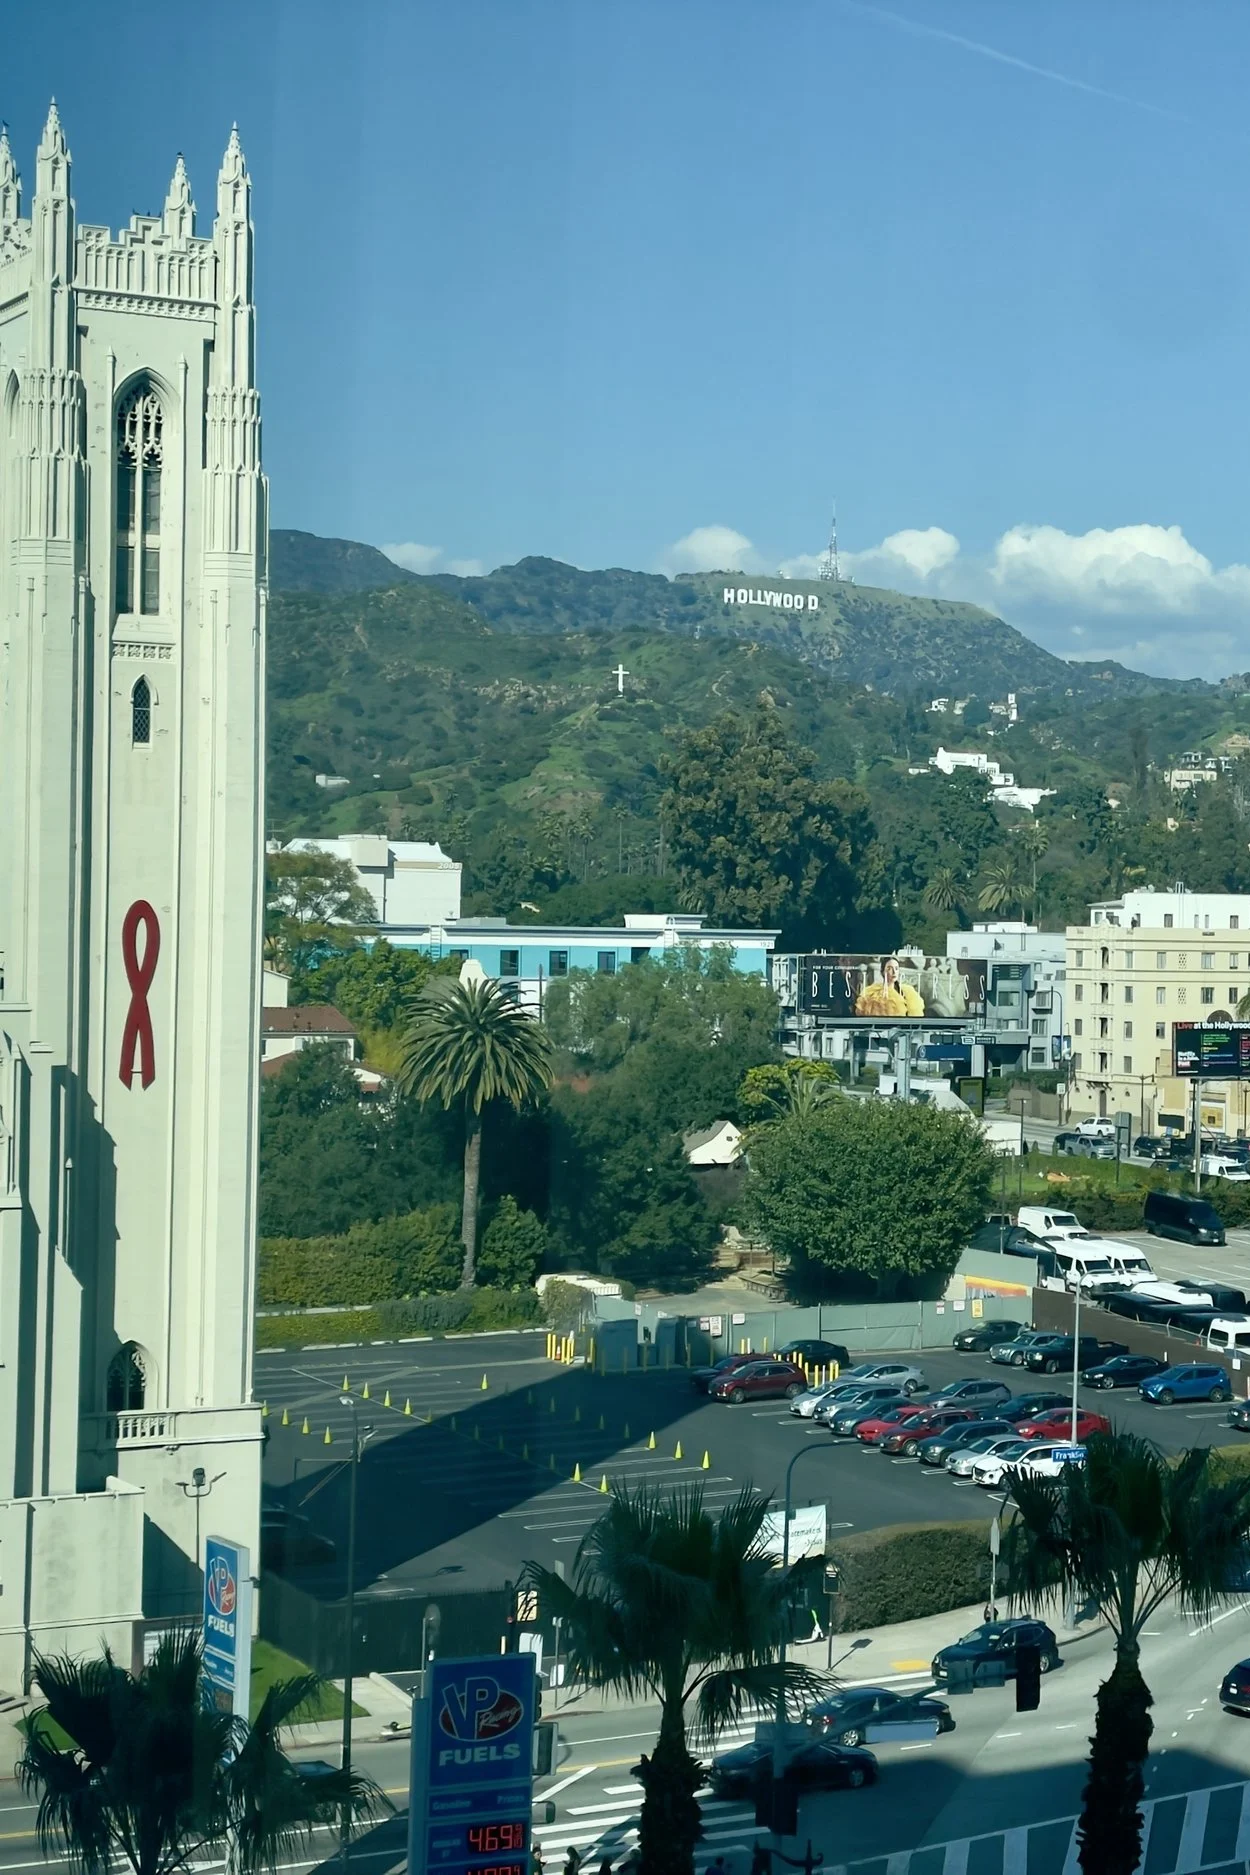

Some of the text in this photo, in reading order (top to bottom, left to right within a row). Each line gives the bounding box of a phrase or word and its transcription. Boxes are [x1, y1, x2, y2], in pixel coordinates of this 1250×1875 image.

[723, 588, 818, 610] HOLLYWOOD
[811, 971, 868, 998] BEST
[207, 1614, 235, 1637] FUELS
[442, 1676, 500, 1741] VP
[438, 1743, 521, 1767] FUELS
[469, 1824, 513, 1852] 4.69
